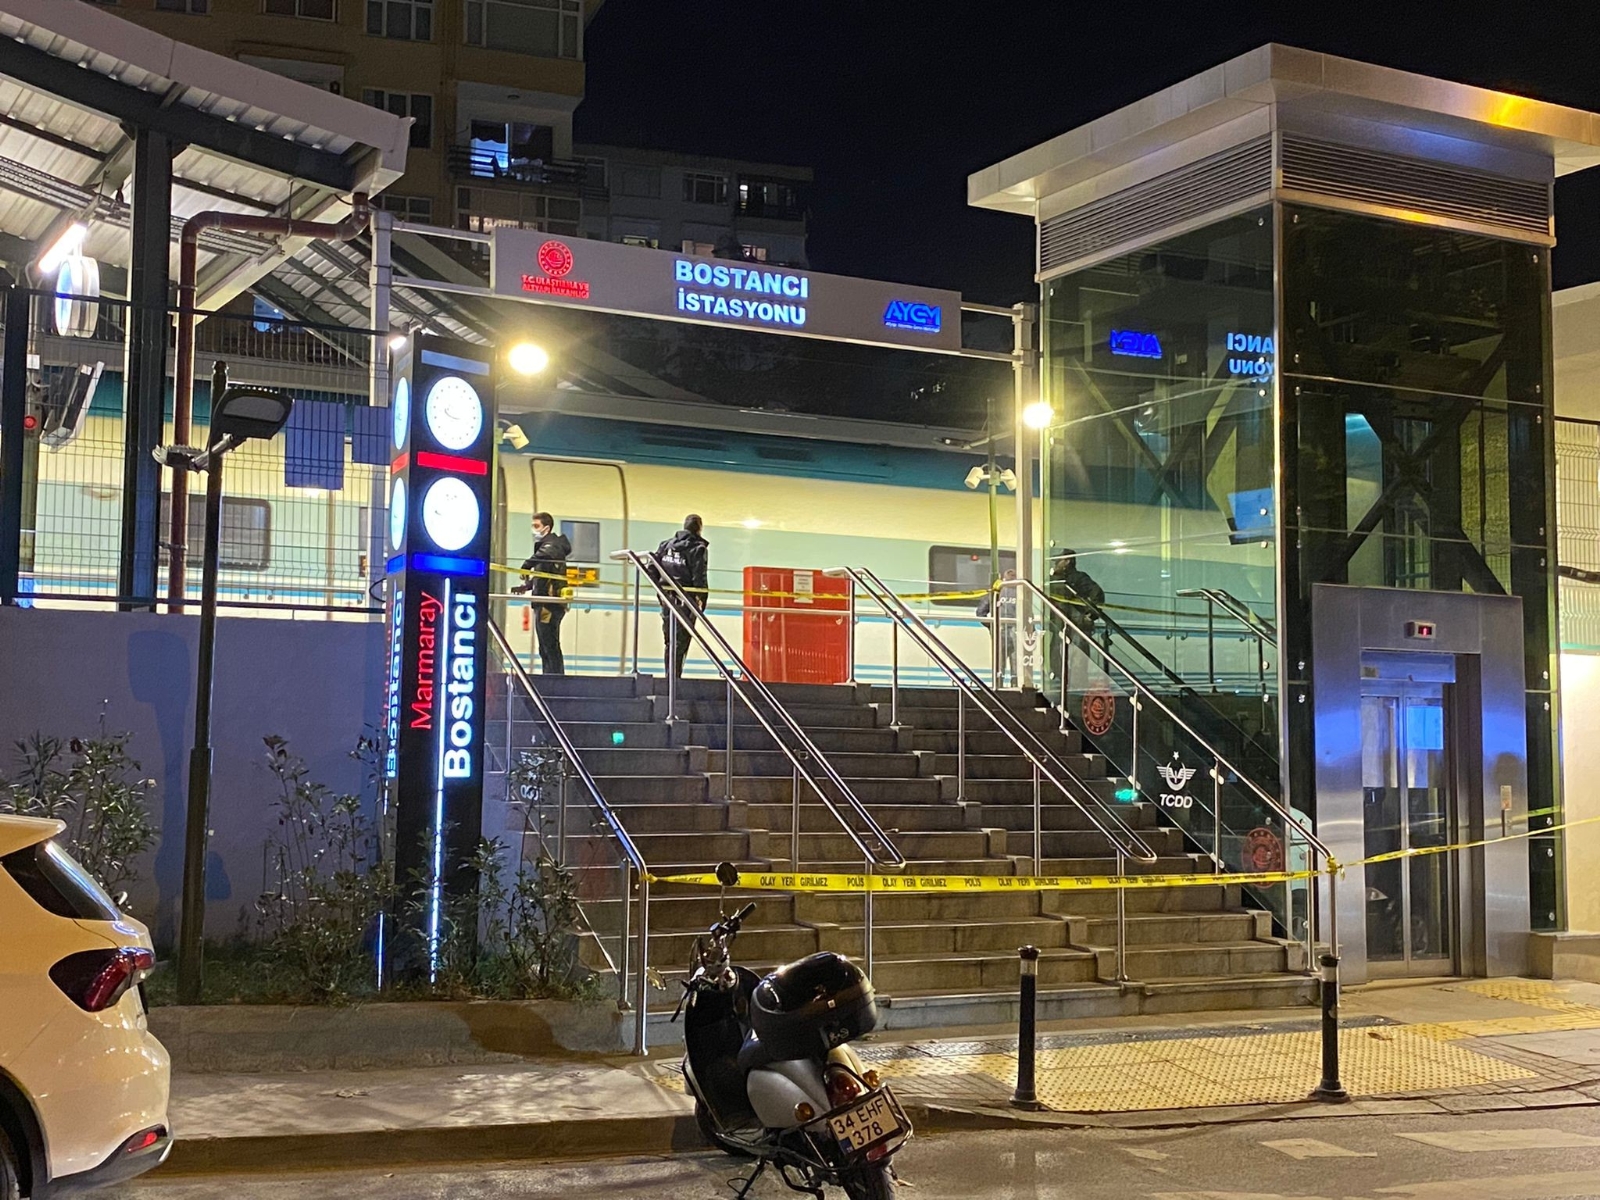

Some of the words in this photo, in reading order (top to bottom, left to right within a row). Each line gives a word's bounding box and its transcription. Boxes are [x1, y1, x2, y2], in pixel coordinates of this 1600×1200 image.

[675, 260, 808, 298] BOSTANCI
[678, 288, 806, 325] İSTASYONU
[411, 591, 444, 729] Marmaray
[444, 593, 476, 778] Bostancı
[1159, 793, 1193, 809] TCDD
[760, 876, 776, 886] OLAY
[834, 1114, 855, 1134] 34
[856, 1098, 883, 1123] EHF
[852, 1121, 883, 1145] 378
